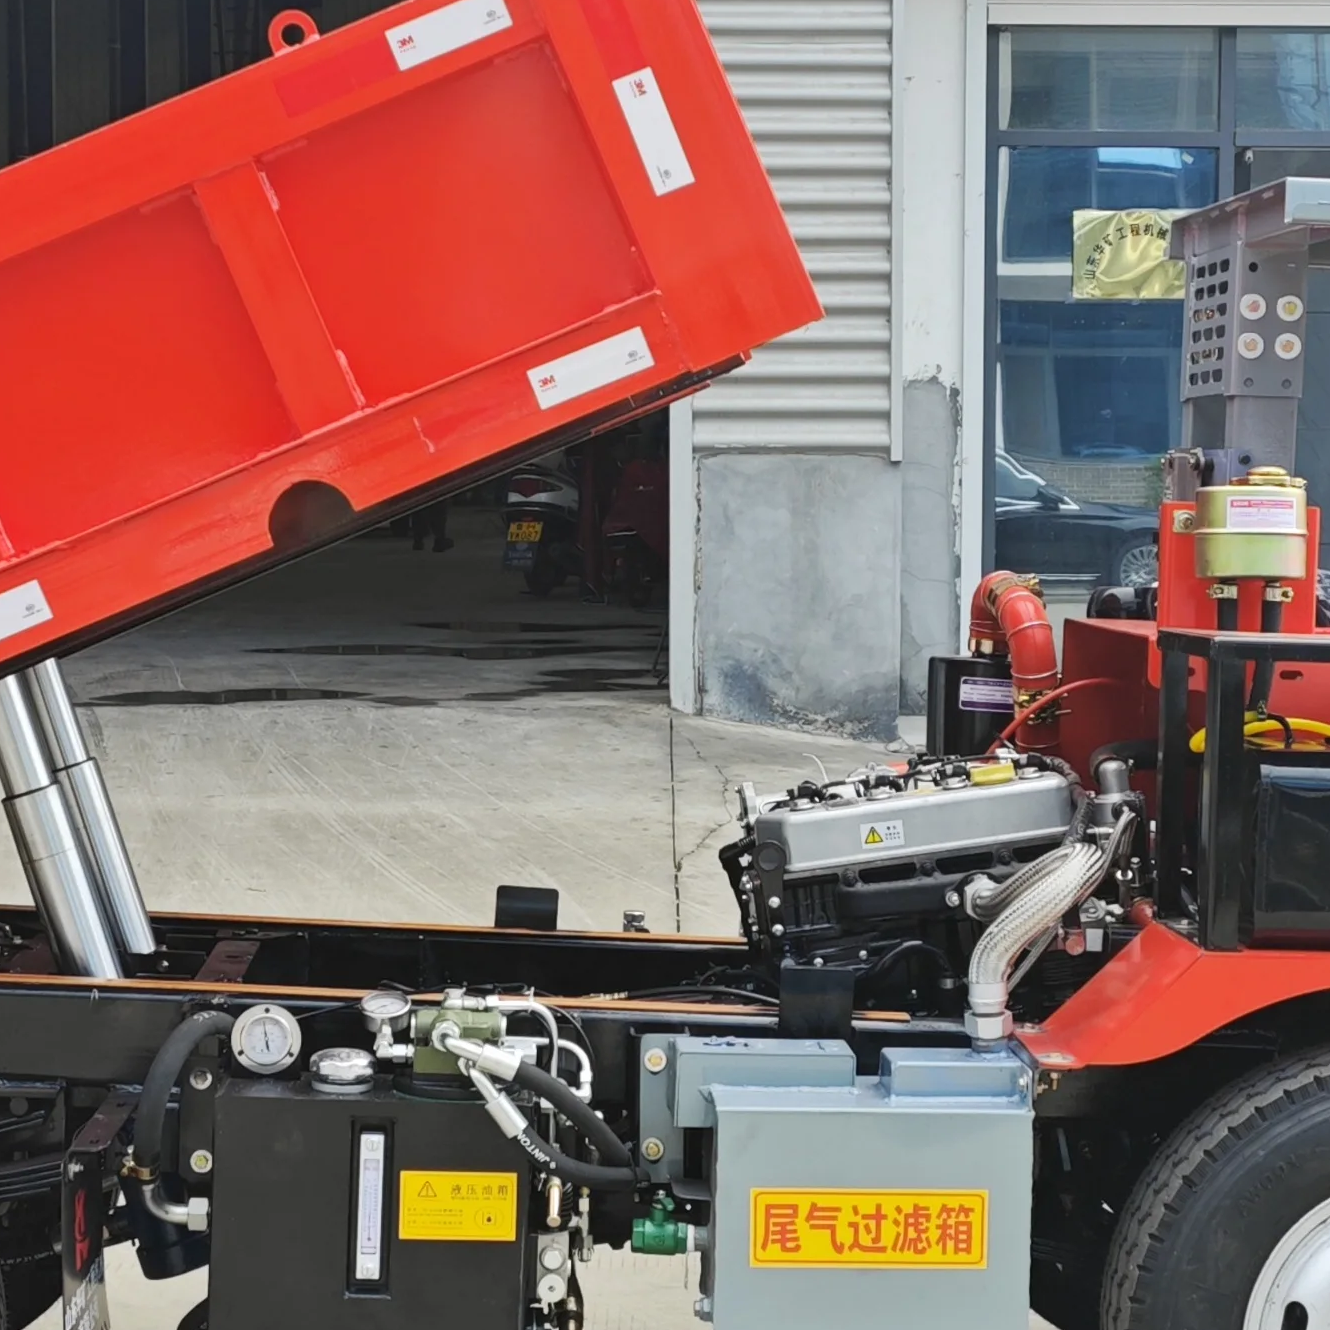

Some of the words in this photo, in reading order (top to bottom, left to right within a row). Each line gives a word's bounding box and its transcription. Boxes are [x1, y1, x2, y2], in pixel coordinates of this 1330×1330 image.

[397, 35, 414, 49] 3M
[634, 78, 647, 97] 3M
[538, 374, 556, 388] 3M
[450, 1184, 509, 1196] 液压油箱
[759, 1202, 976, 1256] 尾气过滤箱
